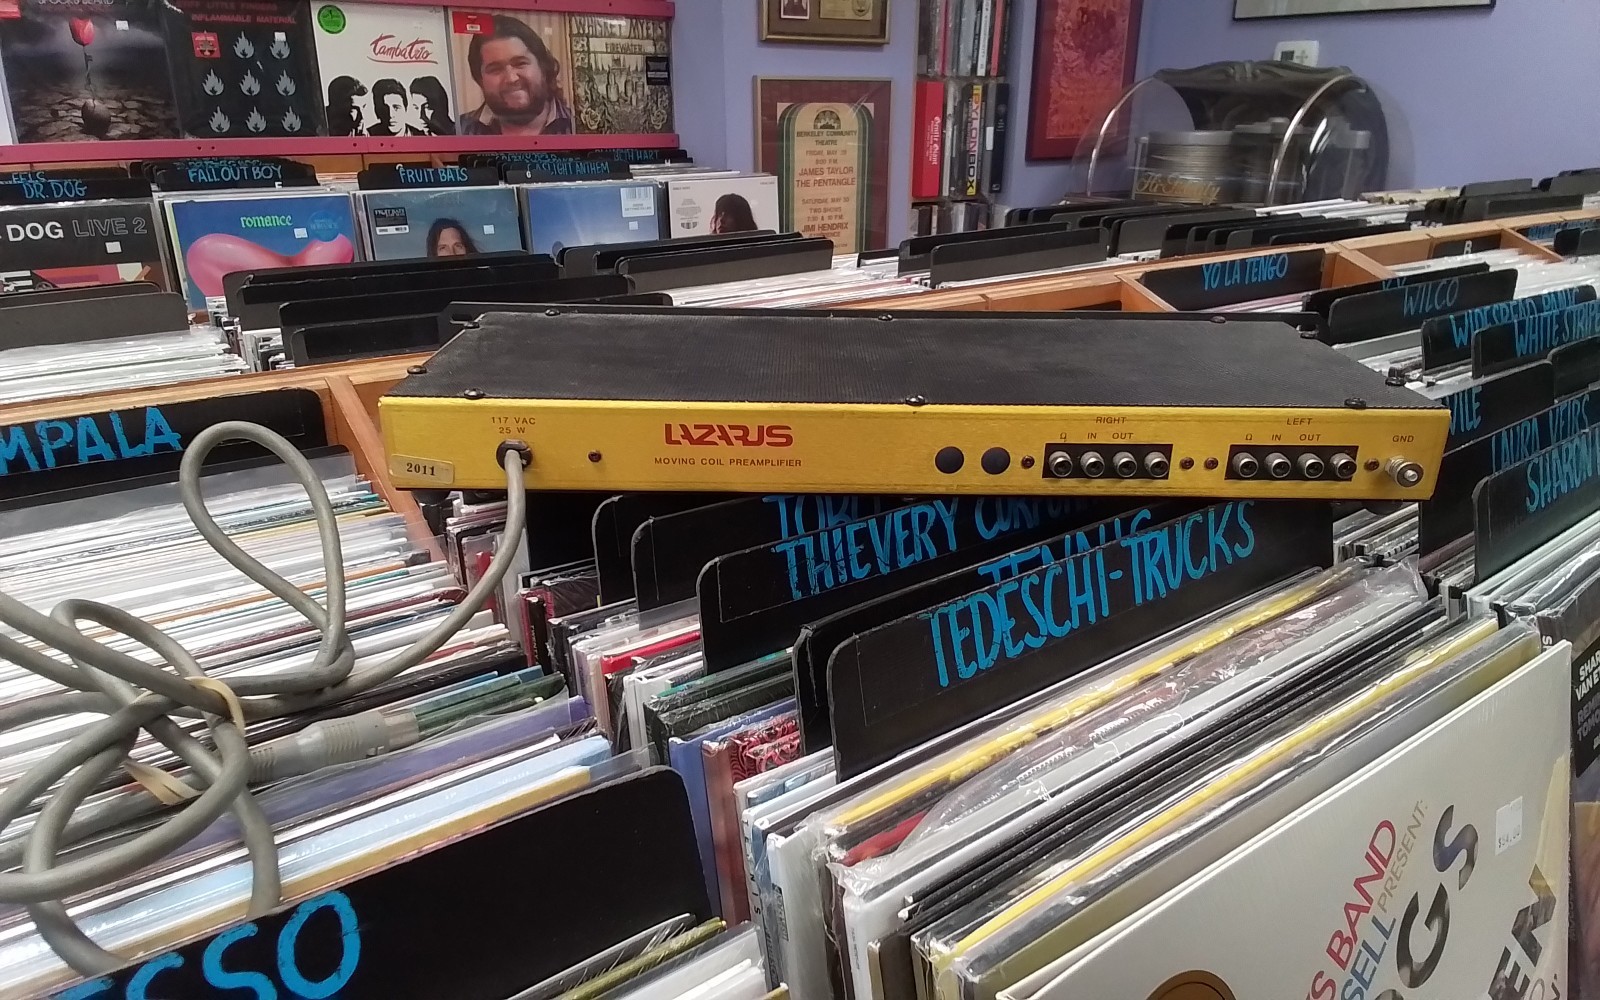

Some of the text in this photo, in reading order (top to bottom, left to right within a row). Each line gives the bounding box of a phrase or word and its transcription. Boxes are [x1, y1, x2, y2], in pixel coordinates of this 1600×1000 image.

[257, 16, 296, 24] MATERIAL
[188, 163, 282, 183] FALL OUT BOY
[574, 161, 611, 175] ANTHEM
[798, 166, 854, 176] JAMES TAYLOR
[400, 166, 468, 184] FRUIT BATS
[22, 179, 88, 199] DR. DOG
[796, 177, 857, 188] THE PENTANGLE
[240, 215, 293, 228] romance
[801, 222, 849, 233] JIMI HENDRIX
[5, 216, 148, 242] DOG LIVE 2
[1202, 254, 1288, 291] YO LA TENGO
[1403, 277, 1460, 318] WILCO
[1514, 309, 1560, 358] WHITE
[491, 416, 536, 425] 117 VAC
[1095, 416, 1127, 425] RIGHT
[1286, 417, 1313, 426] LEFT
[498, 426, 512, 434] 25
[664, 423, 794, 448] LAZARUS
[1087, 432, 1097, 440] IN
[1112, 432, 1134, 440] OUT
[1271, 434, 1282, 442] IN
[1299, 434, 1321, 442] OUT
[1392, 435, 1414, 443] GND
[654, 457, 802, 467] MOVING COIL PREAMPLIFIER
[406, 463, 436, 476] 2011
[1526, 430, 1593, 513] SHARON
[770, 497, 959, 601] THIEVERY
[917, 501, 1256, 688] TEDESCHI-TRUCKS
[1575, 674, 1593, 702] VAN
[1325, 819, 1397, 972] BAND
